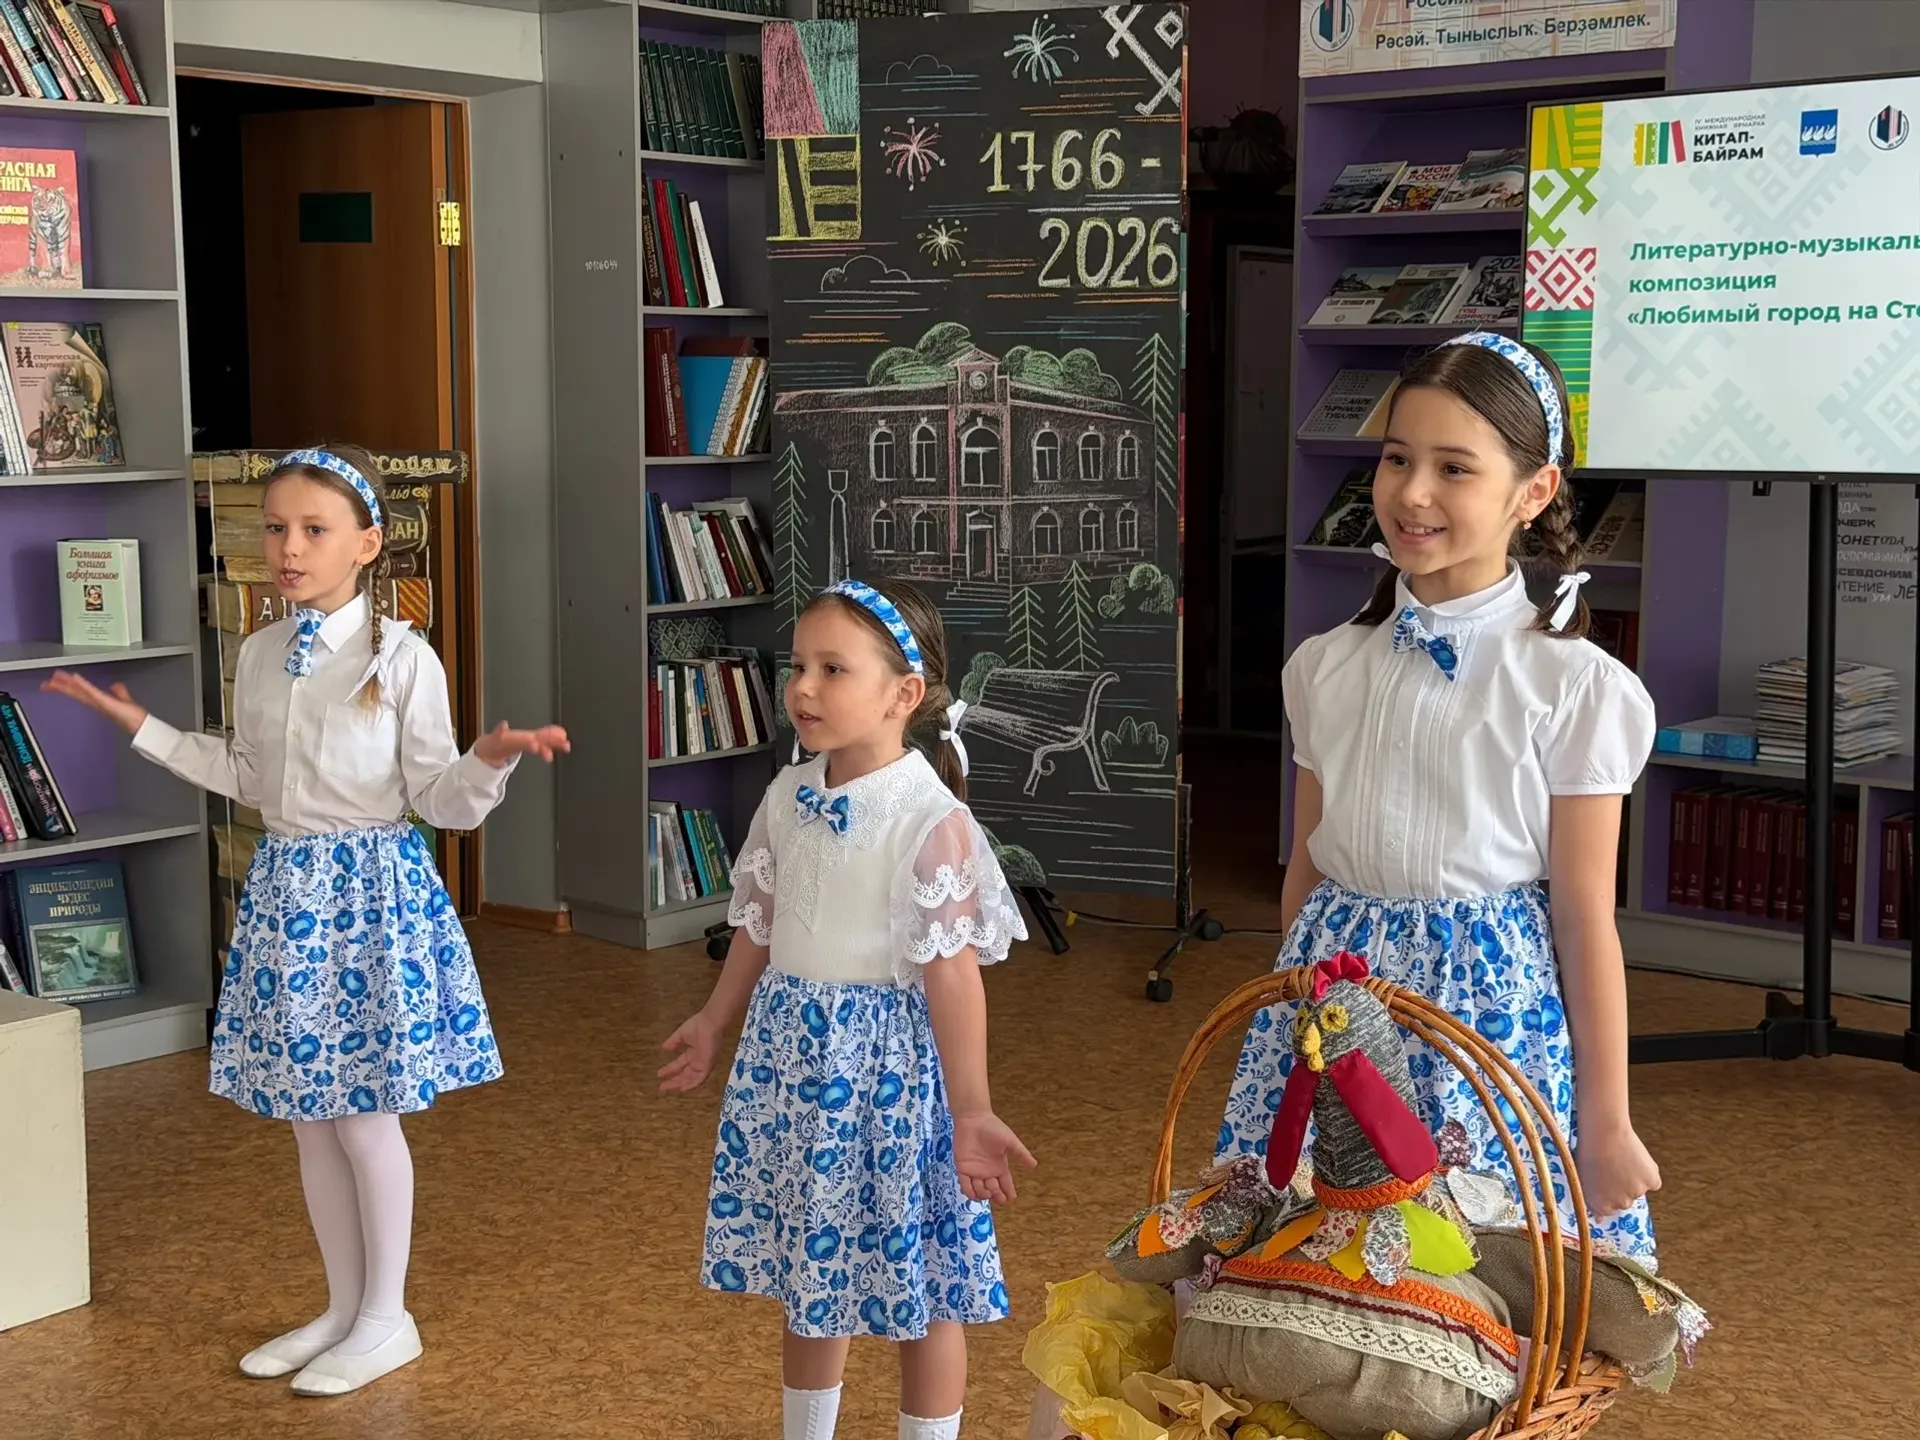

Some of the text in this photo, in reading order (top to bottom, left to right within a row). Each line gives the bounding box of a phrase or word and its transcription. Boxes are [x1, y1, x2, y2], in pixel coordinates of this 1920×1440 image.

[1376, 30, 1429, 50] Рәсәй.
[1693, 131, 1755, 147] КИТАП-
[979, 128, 1125, 193] 1766
[1692, 146, 1764, 163] БАЙРАМ
[1038, 217, 1181, 288] 2026
[1629, 274, 1777, 293] композиция
[1627, 303, 1760, 325] «Любимый
[1767, 306, 1841, 325] город
[1848, 304, 1878, 320] на
[385, 484, 410, 500] льд
[390, 521, 420, 540] АН
[1837, 568, 1913, 579] СЕВДОНИМ
[1893, 584, 1917, 600] ЛЕ
[49, 903, 101, 917] ПРИРОДЫ
